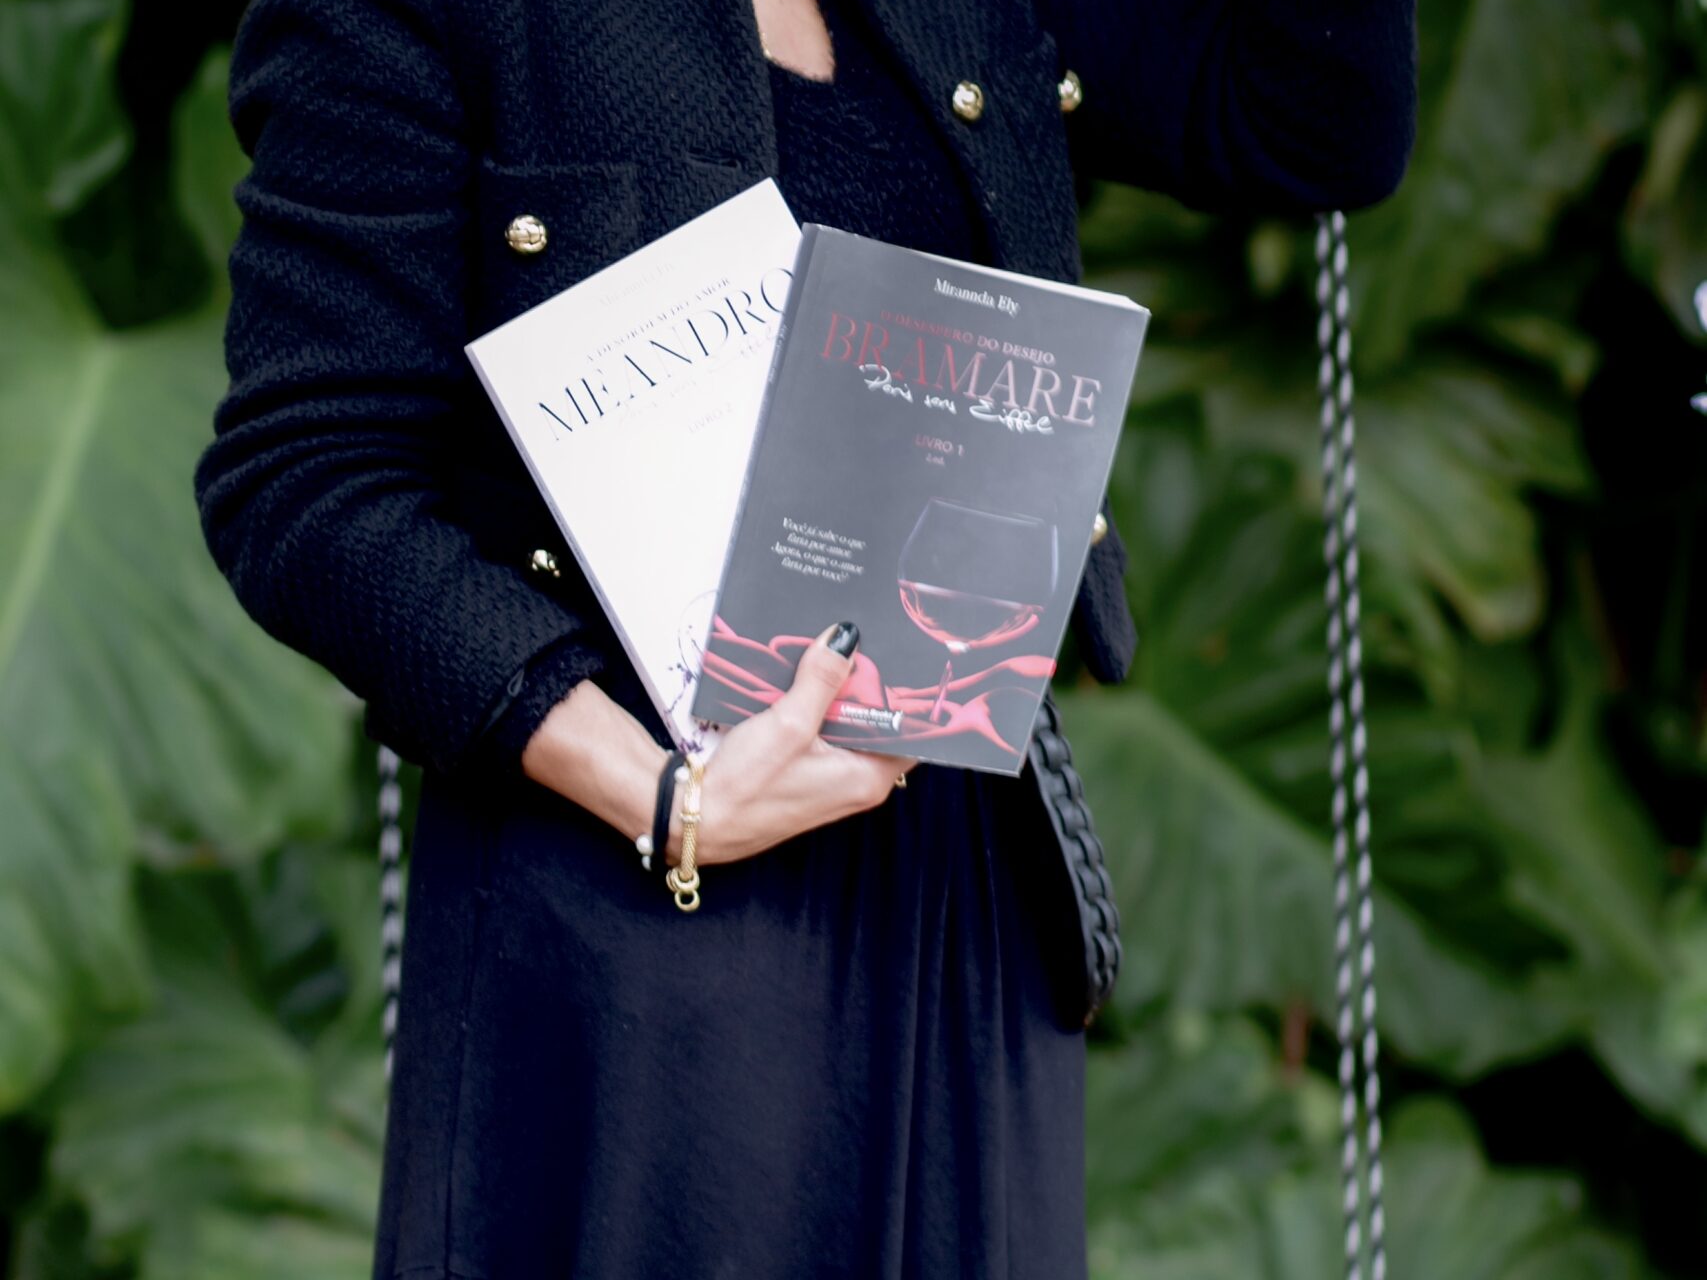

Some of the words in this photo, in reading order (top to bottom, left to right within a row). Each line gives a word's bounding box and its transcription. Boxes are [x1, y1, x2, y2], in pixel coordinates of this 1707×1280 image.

[934, 278, 995, 308] Mirannda
[997, 294, 1020, 318] Ely
[895, 313, 974, 344] DESESPERO
[976, 333, 1000, 351] DO
[1002, 341, 1056, 366] DESEJO
[820, 310, 1103, 428] BRAMARE
[915, 434, 953, 455] LIVRO
